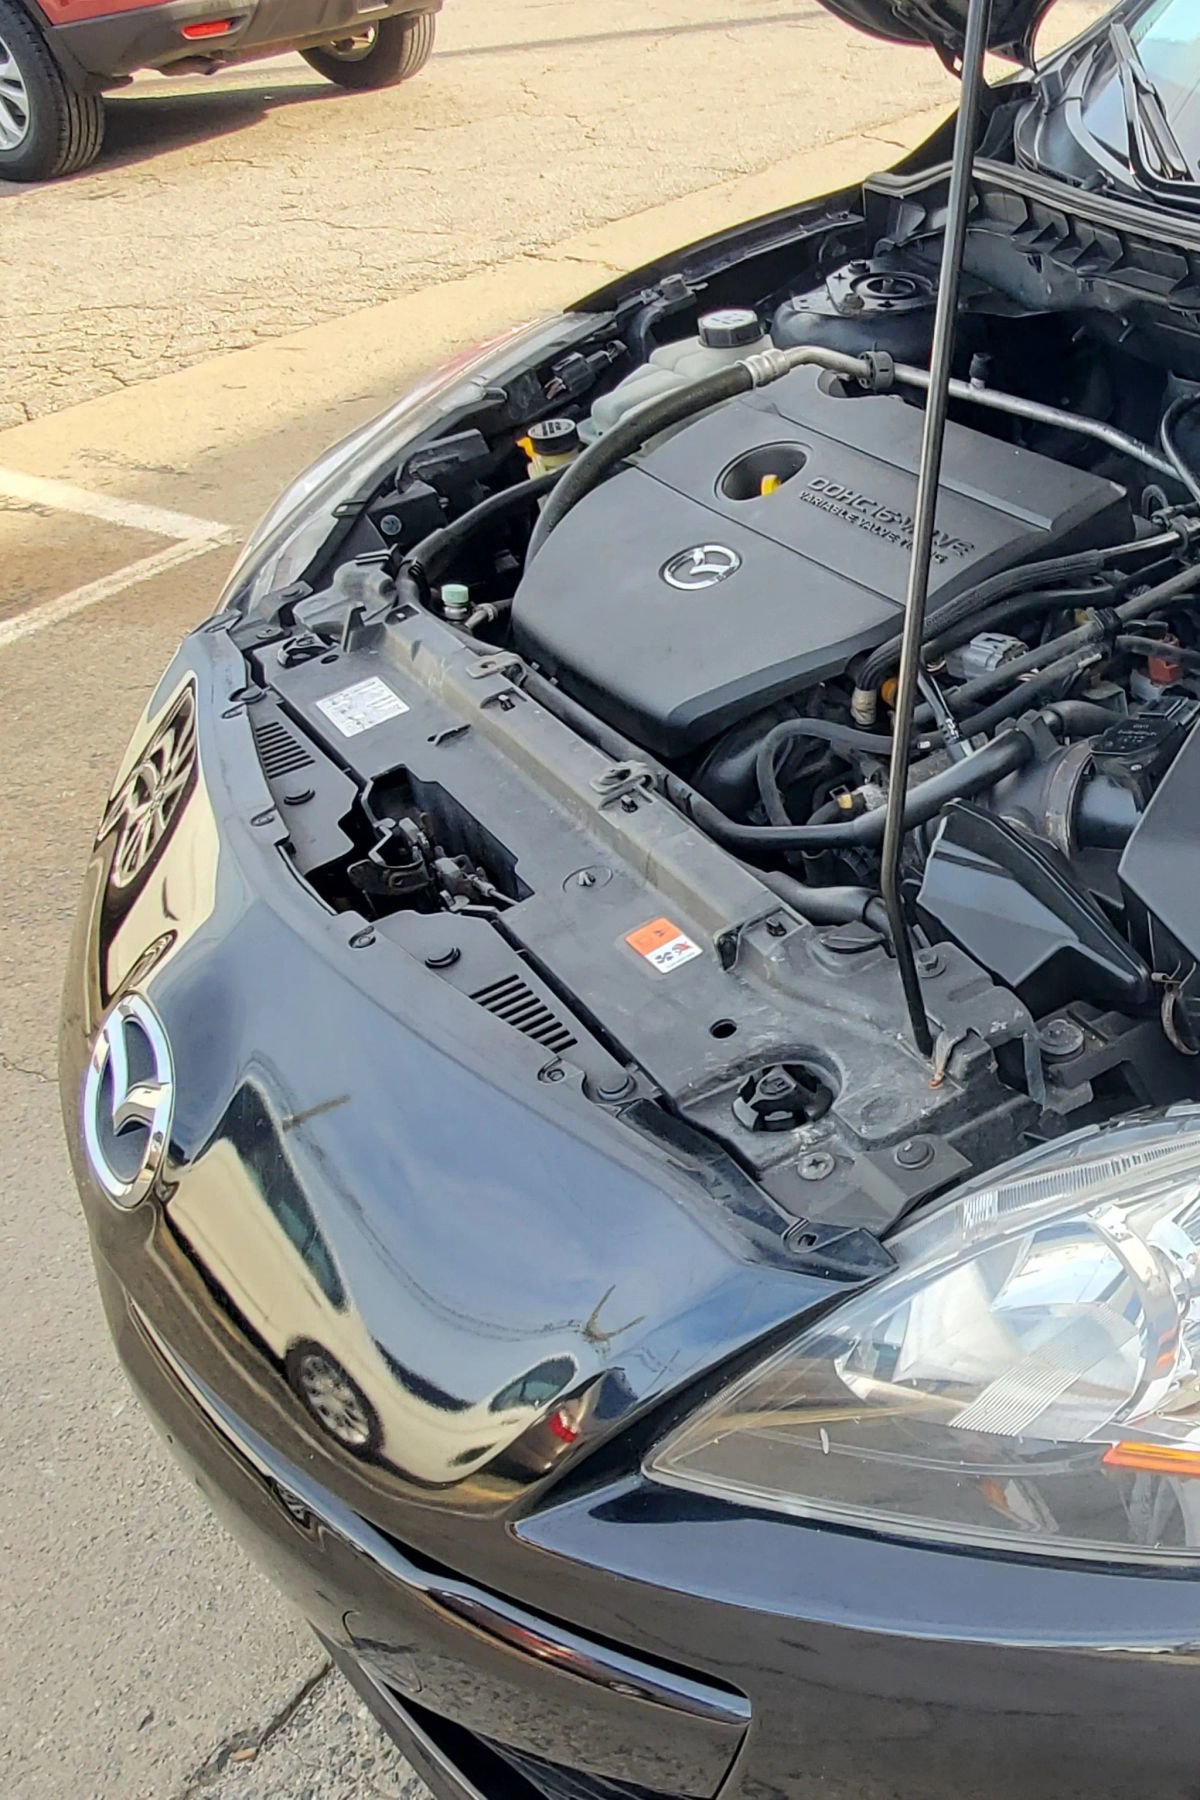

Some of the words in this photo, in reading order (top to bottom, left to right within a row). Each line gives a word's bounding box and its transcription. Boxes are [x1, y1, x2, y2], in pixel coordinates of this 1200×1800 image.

[799, 490, 860, 524] VARIABLE
[858, 518, 900, 543] VALVE
[807, 477, 877, 514] DOHC
